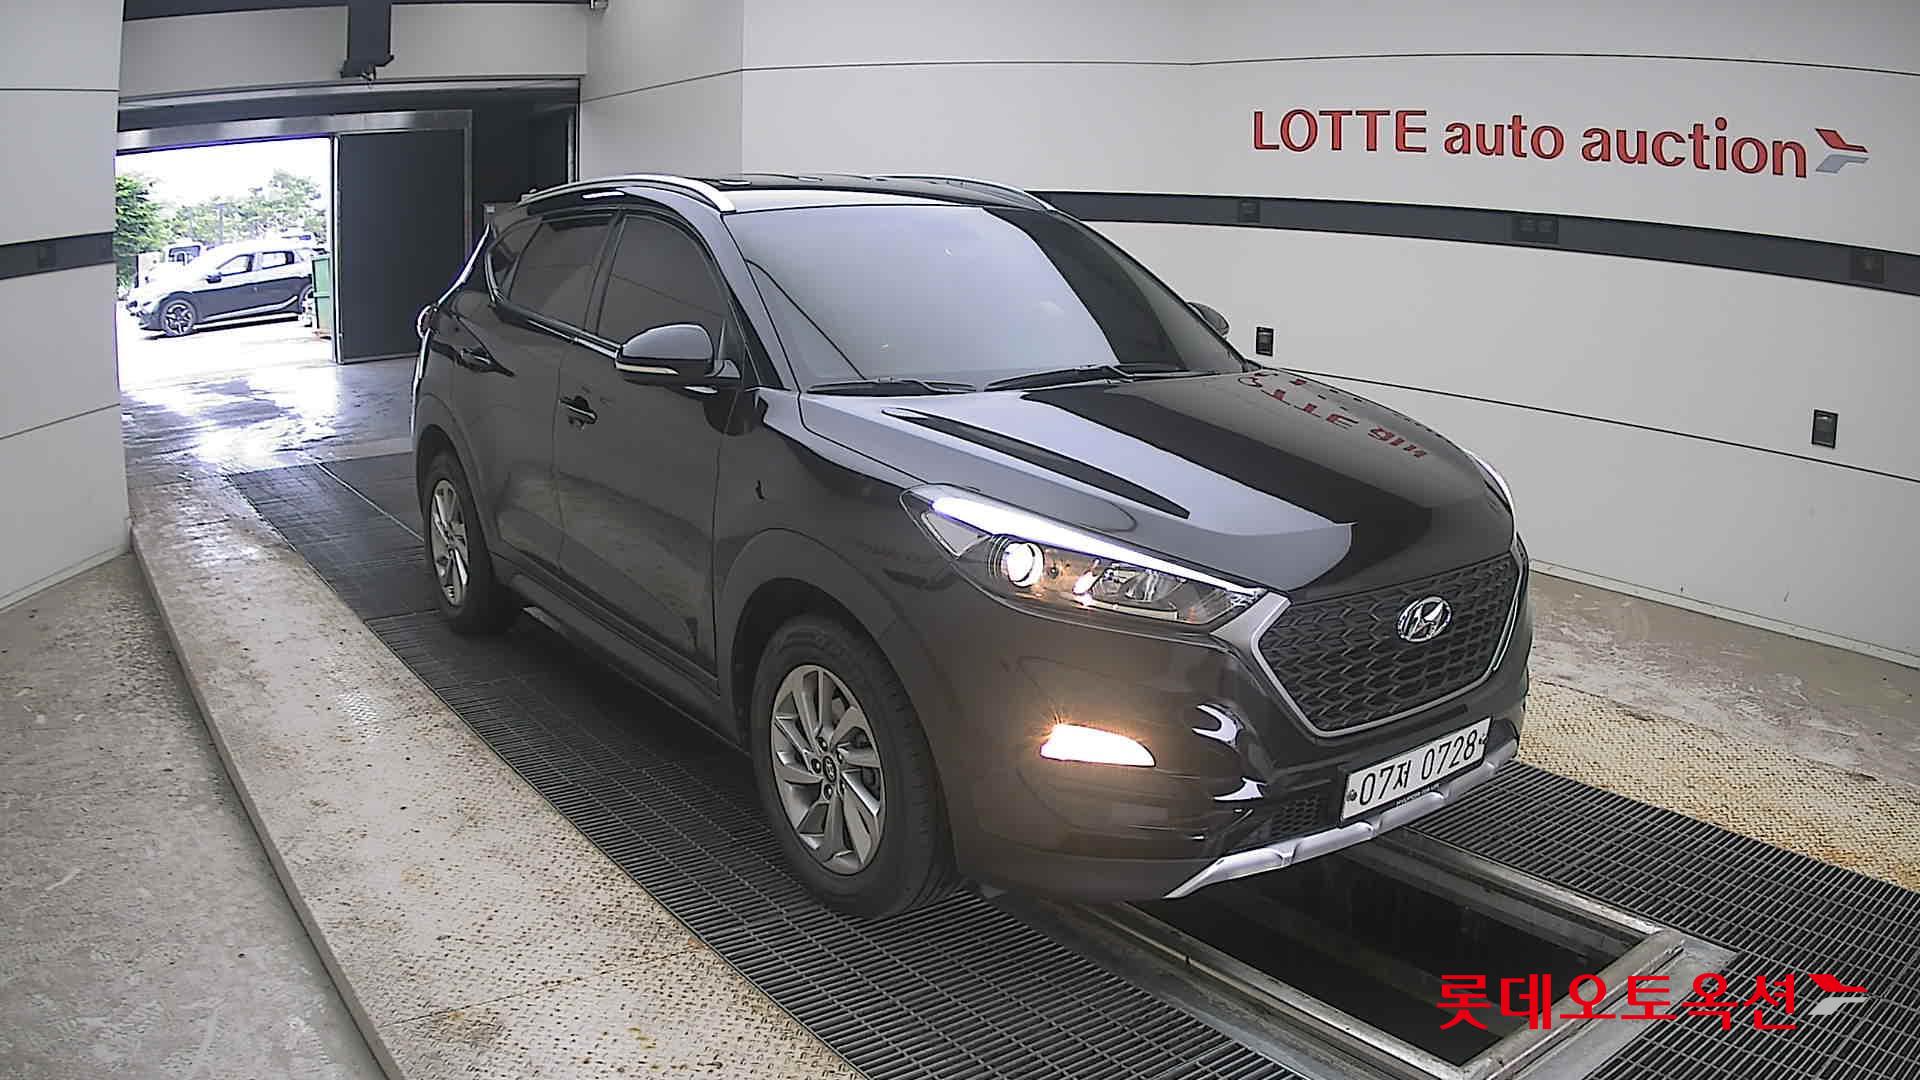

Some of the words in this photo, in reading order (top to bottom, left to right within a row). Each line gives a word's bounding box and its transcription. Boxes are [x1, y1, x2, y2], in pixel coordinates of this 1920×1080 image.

[1253, 110, 1427, 153] LOTTE
[1444, 114, 1566, 159] auto
[1582, 117, 1808, 178] auction
[1359, 760, 1412, 806] 07저
[1421, 729, 1478, 781] 0728
